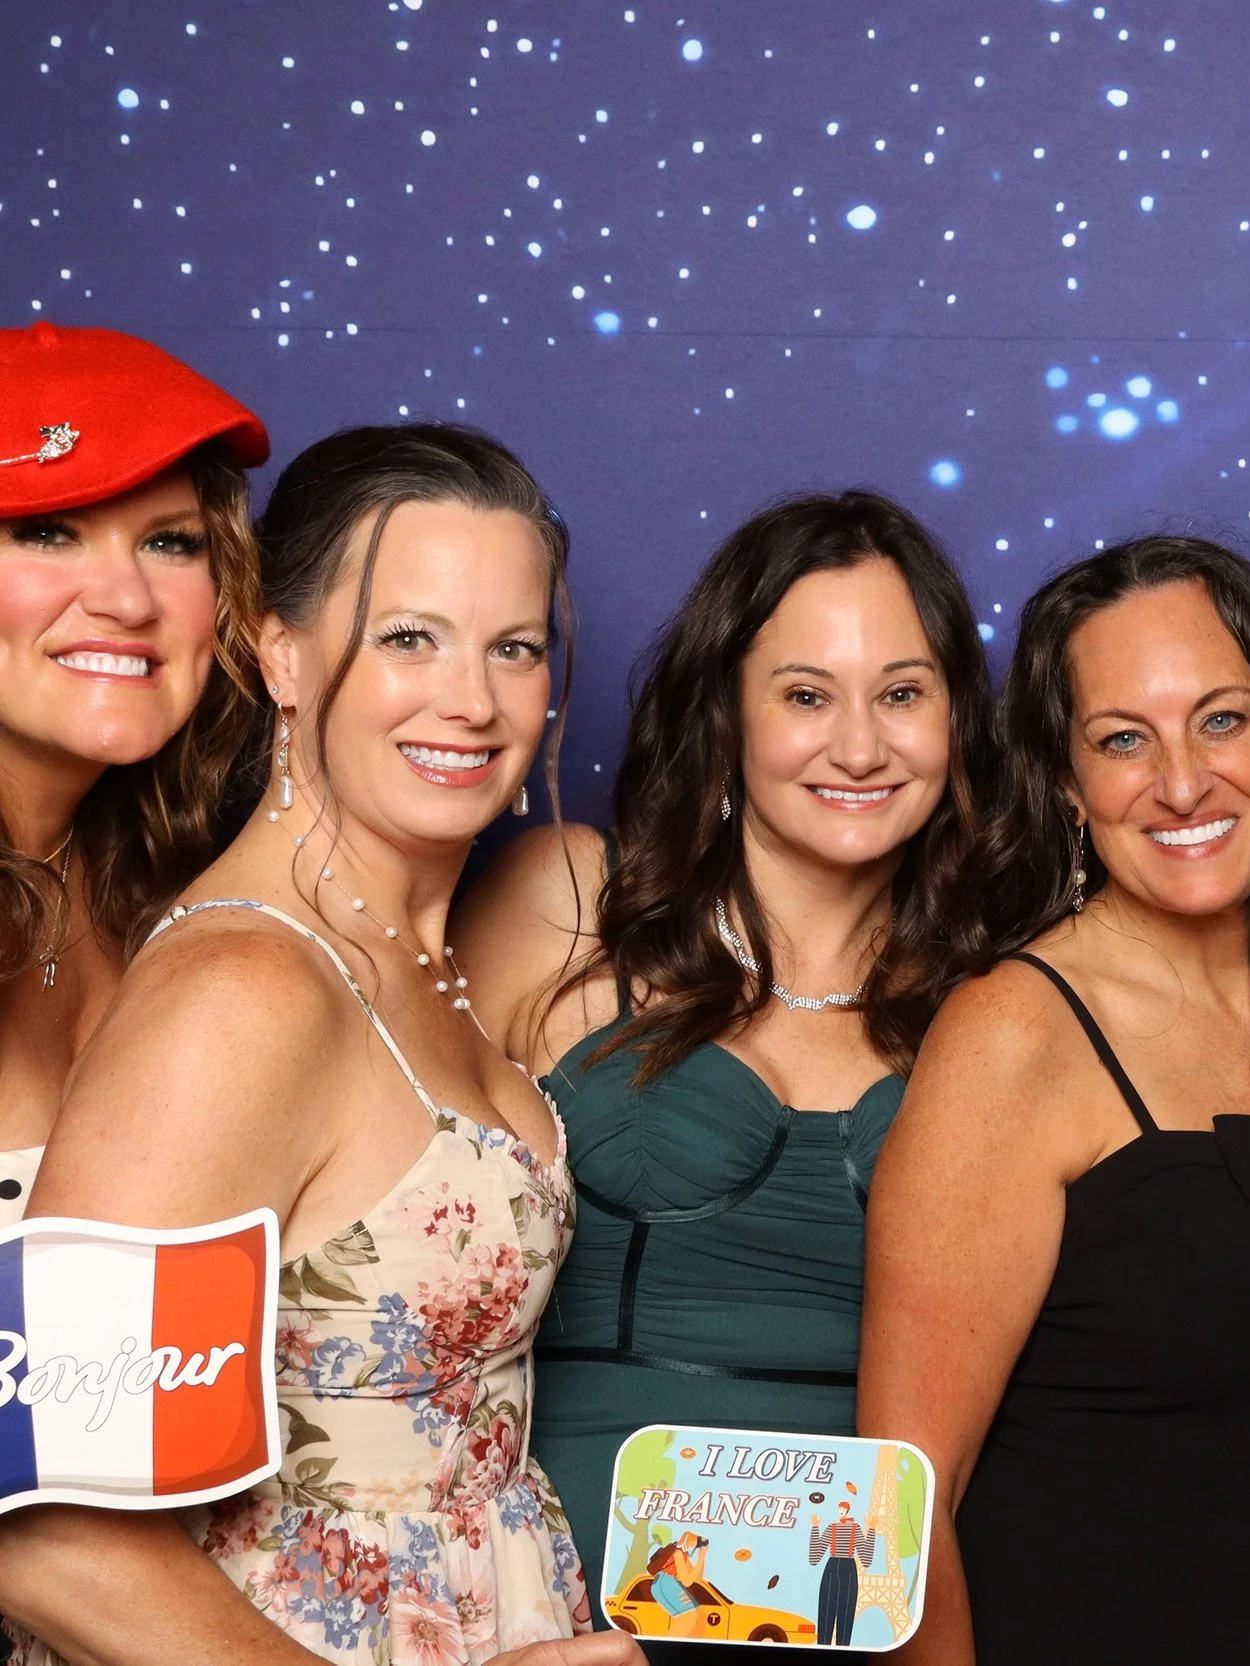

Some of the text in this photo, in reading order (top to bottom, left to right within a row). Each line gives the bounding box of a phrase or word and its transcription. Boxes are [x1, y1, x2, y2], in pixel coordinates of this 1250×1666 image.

[699, 1444, 837, 1483] I LOVE
[634, 1488, 800, 1529] FRANCE
[709, 1614, 719, 1625] T
